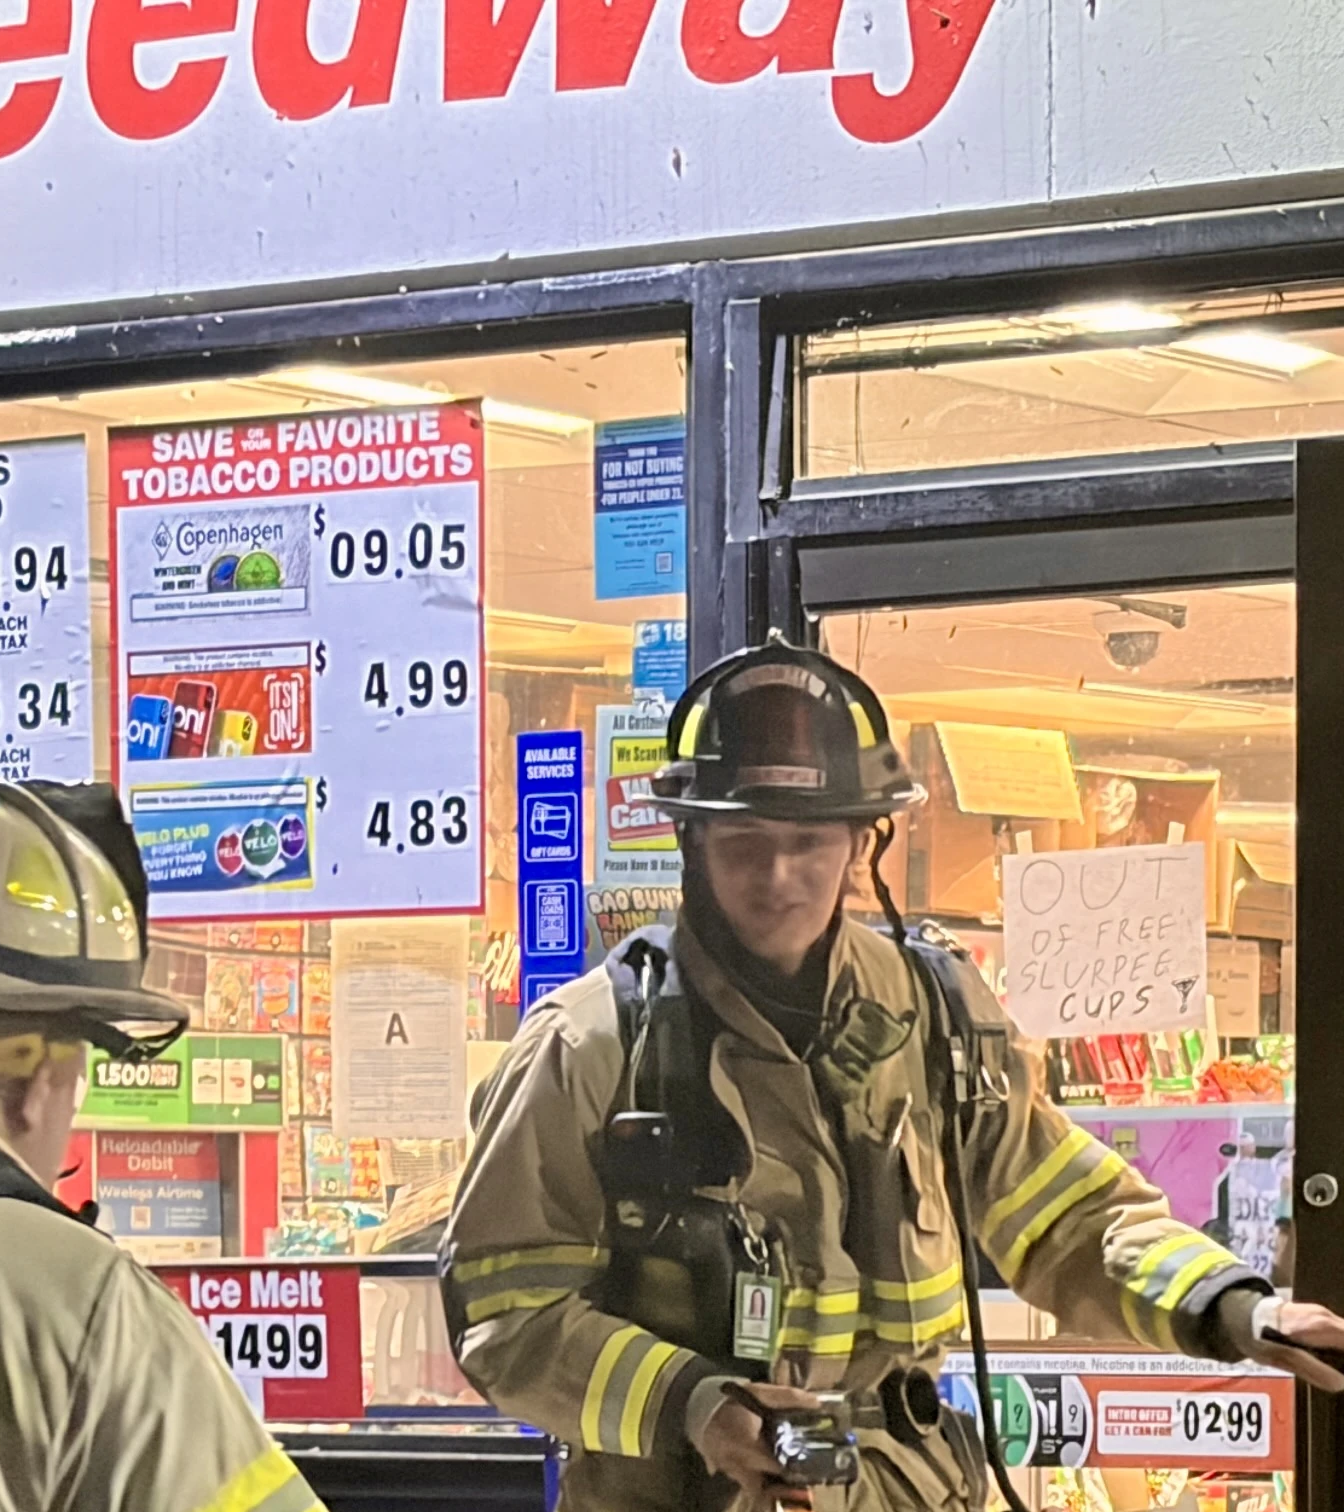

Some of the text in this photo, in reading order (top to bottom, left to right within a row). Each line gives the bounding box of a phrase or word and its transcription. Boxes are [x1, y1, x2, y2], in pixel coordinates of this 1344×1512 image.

[152, 411, 441, 463] SAVE FAVORITE
[122, 444, 474, 501] TOBACCO PRODUCTS
[602, 456, 684, 479] FOR NOT BUYING
[619, 491, 645, 505] PEOPLE
[176, 522, 284, 556] Copenhagen
[364, 659, 468, 717] 4.99
[525, 747, 577, 763] AVAILABLE
[527, 764, 574, 780] SERVICES
[367, 796, 468, 854] 4.83
[245, 836, 278, 851] VELO
[170, 864, 204, 879] KNOW
[1020, 856, 1189, 915] OUT
[588, 887, 684, 914] BAO BUN'
[1096, 911, 1178, 948] FREE
[1020, 949, 1173, 993] SLURPEE
[385, 1013, 409, 1045] A
[127, 1154, 174, 1172] Debit
[98, 1185, 204, 1200] Wireless Airtime
[190, 1270, 324, 1310] Ice Melt
[1091, 1358, 1136, 1371] Nicotine
[1138, 1359, 1147, 1371] is
[1149, 1361, 1163, 1372] an
[1165, 1358, 1214, 1372] addictive
[1106, 1408, 1170, 1423] INTRO OFFER
